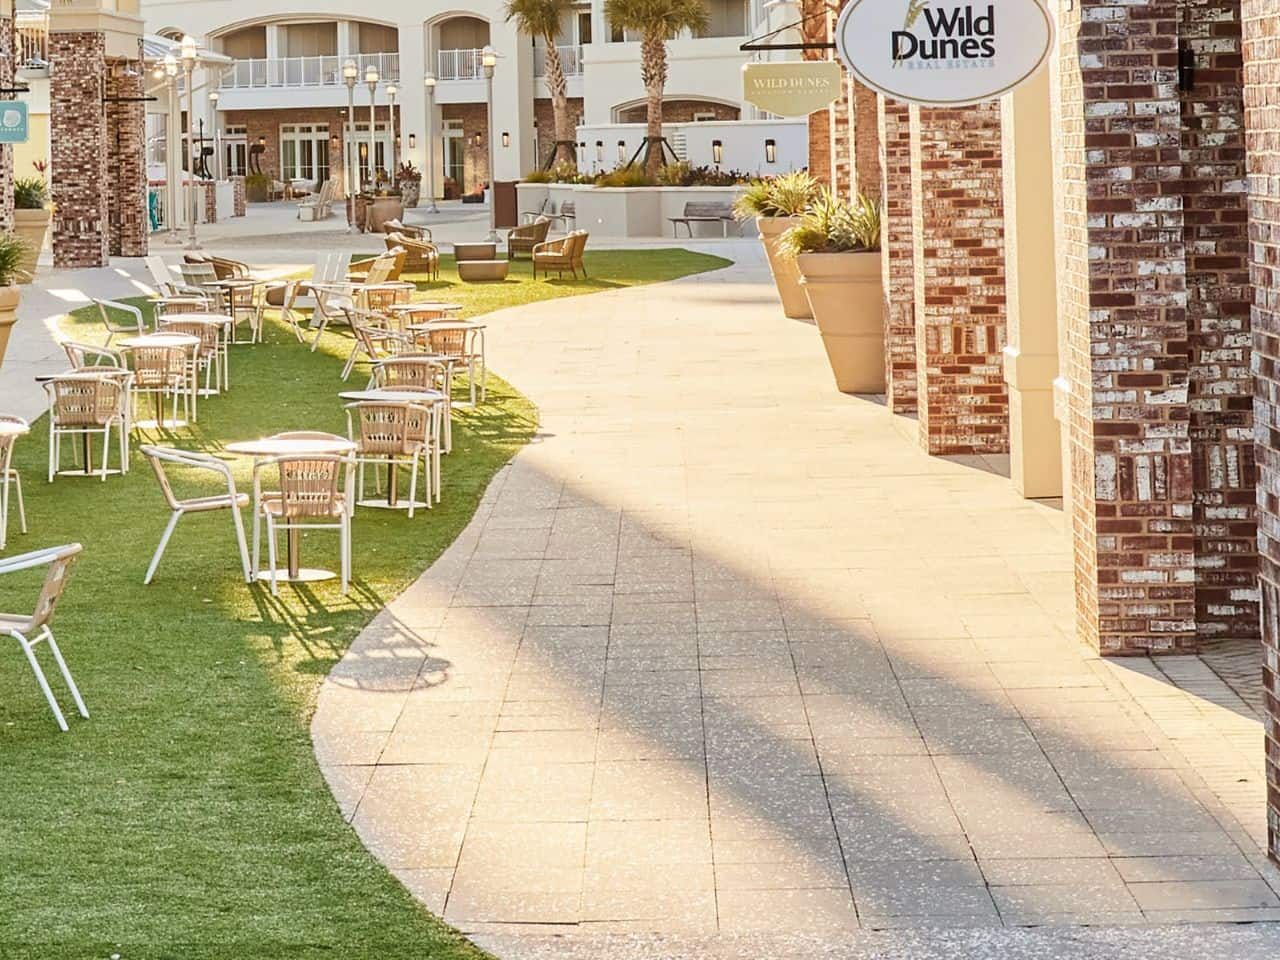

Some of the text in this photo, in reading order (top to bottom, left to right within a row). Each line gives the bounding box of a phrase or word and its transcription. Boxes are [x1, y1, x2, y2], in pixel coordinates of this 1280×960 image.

[923, 5, 995, 37] Wild
[891, 30, 996, 61] Dunes
[907, 59, 996, 70] REAL ESTATE
[753, 77, 831, 89] WILD DUNES
